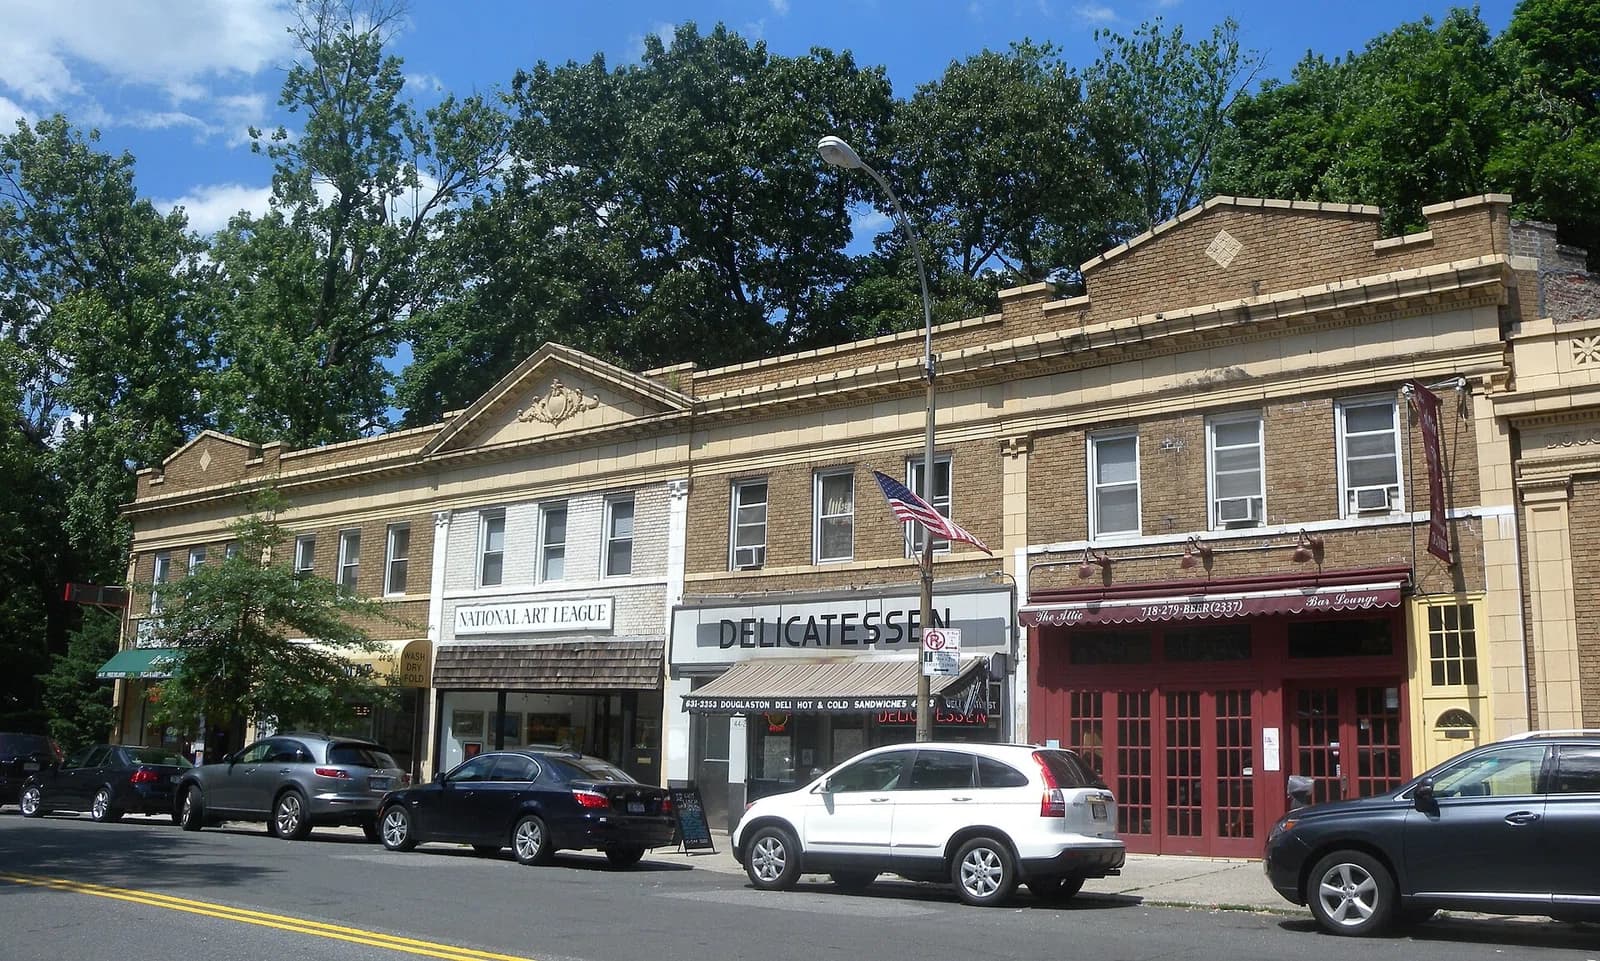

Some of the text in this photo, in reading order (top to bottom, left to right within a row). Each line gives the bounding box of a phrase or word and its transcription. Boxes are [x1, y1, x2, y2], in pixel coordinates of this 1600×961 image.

[1305, 594, 1378, 608] Bar Lounge
[459, 603, 606, 627] NATIONAL ART LEAGUE
[1035, 608, 1083, 622] The Attic
[719, 608, 950, 649] DELICATESSEN
[403, 652, 425, 661] WASH
[407, 663, 422, 672] DRY
[403, 674, 424, 683] FOLD
[720, 700, 770, 709] DOUGLASTON
[775, 700, 792, 709] DELI
[797, 701, 812, 709] HOT
[817, 701, 823, 709] &
[827, 700, 849, 709] COLD
[854, 699, 906, 709] SANDWICHES
